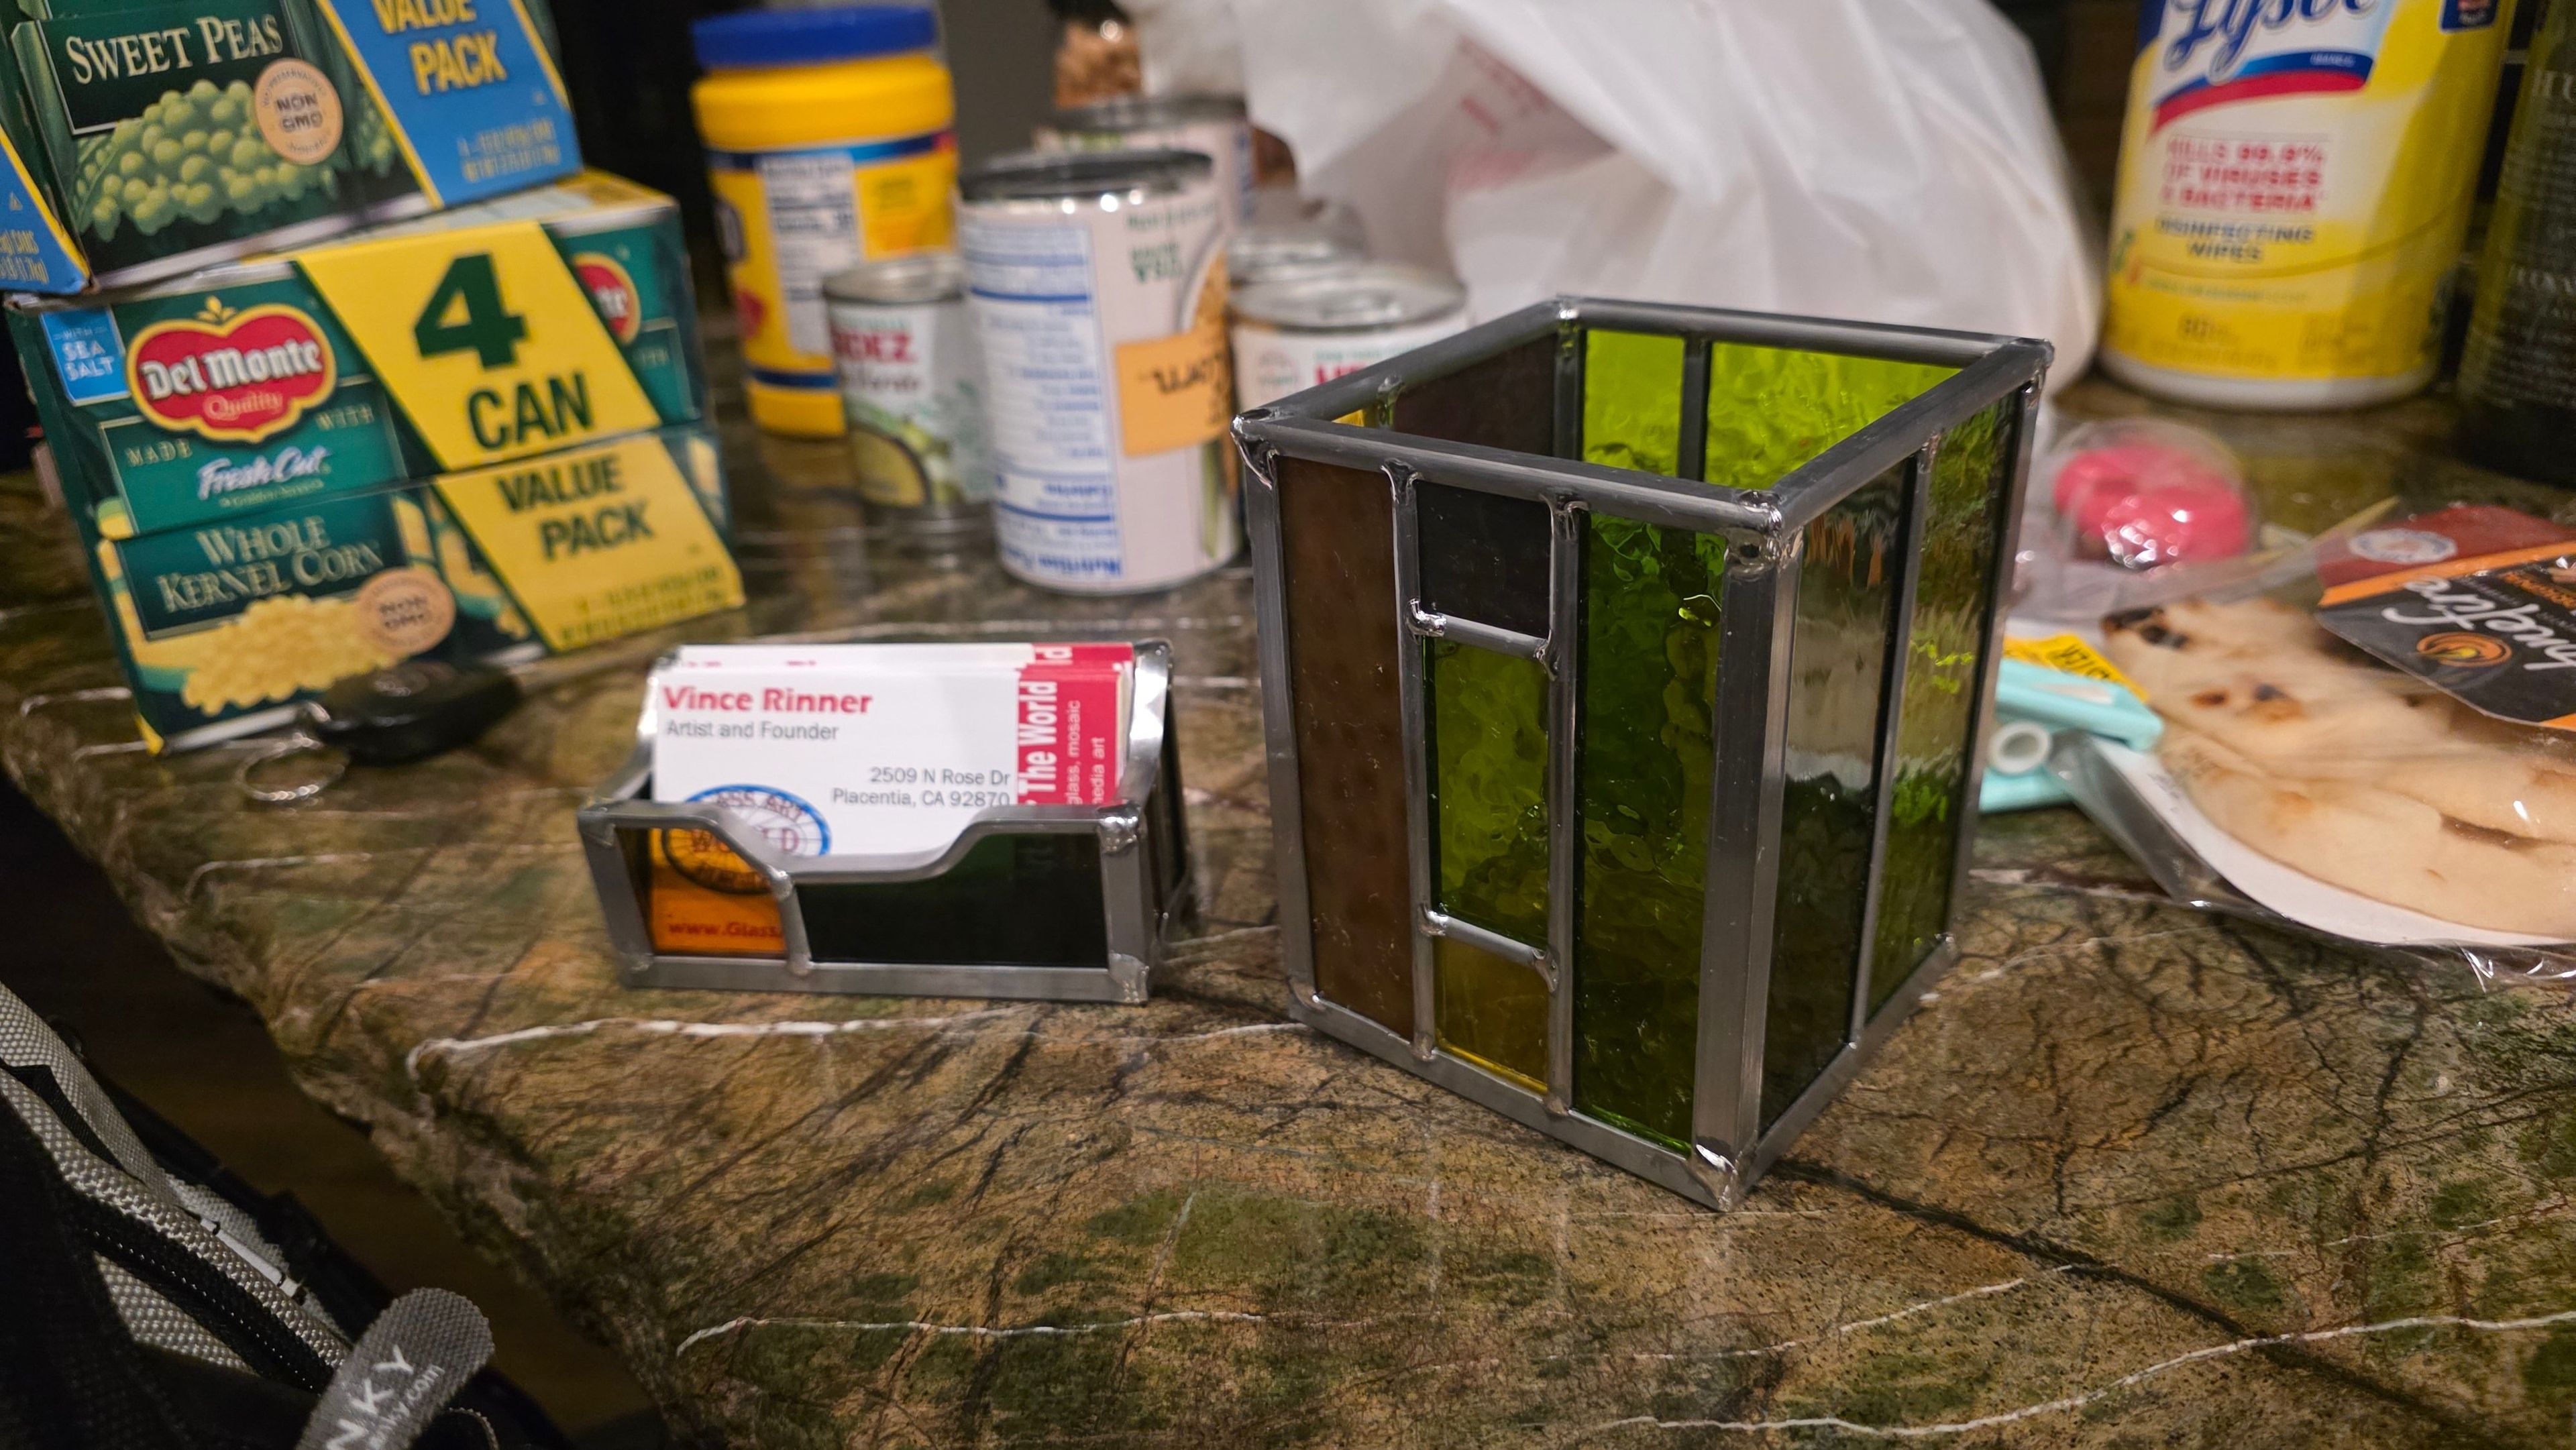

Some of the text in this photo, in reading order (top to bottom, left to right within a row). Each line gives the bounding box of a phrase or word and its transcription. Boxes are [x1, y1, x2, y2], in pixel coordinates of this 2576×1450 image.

[66, 14, 283, 85] SWEET PEAS
[409, 30, 507, 95] PACK
[276, 93, 318, 111] NON
[282, 111, 323, 132] GMO
[2202, 167, 2321, 186] VIRUSES
[2182, 188, 2314, 211] BACTERIA
[414, 252, 528, 371] 4
[64, 327, 93, 338] WITH
[62, 340, 106, 361] SEA
[64, 356, 114, 382] SALT
[140, 337, 323, 400] Del Monte
[203, 390, 283, 422] Quality
[468, 371, 594, 451] CAN
[125, 438, 193, 467] MADE
[197, 445, 331, 500] Fresh Cut
[496, 453, 623, 513] VALUE
[195, 514, 331, 566] WHOLE
[539, 500, 655, 563] PACK
[155, 539, 385, 613] KERNEL CORN
[663, 685, 873, 714] Vince Rinner
[1018, 681, 1057, 747] World
[666, 720, 839, 740] Artist and Founder
[1066, 700, 1081, 759] mosaic
[1091, 737, 1106, 760] art
[870, 767, 1011, 785] 2509 N Rose Dr
[1018, 750, 1057, 795] The
[833, 787, 1011, 808] Placentia, CA 92870
